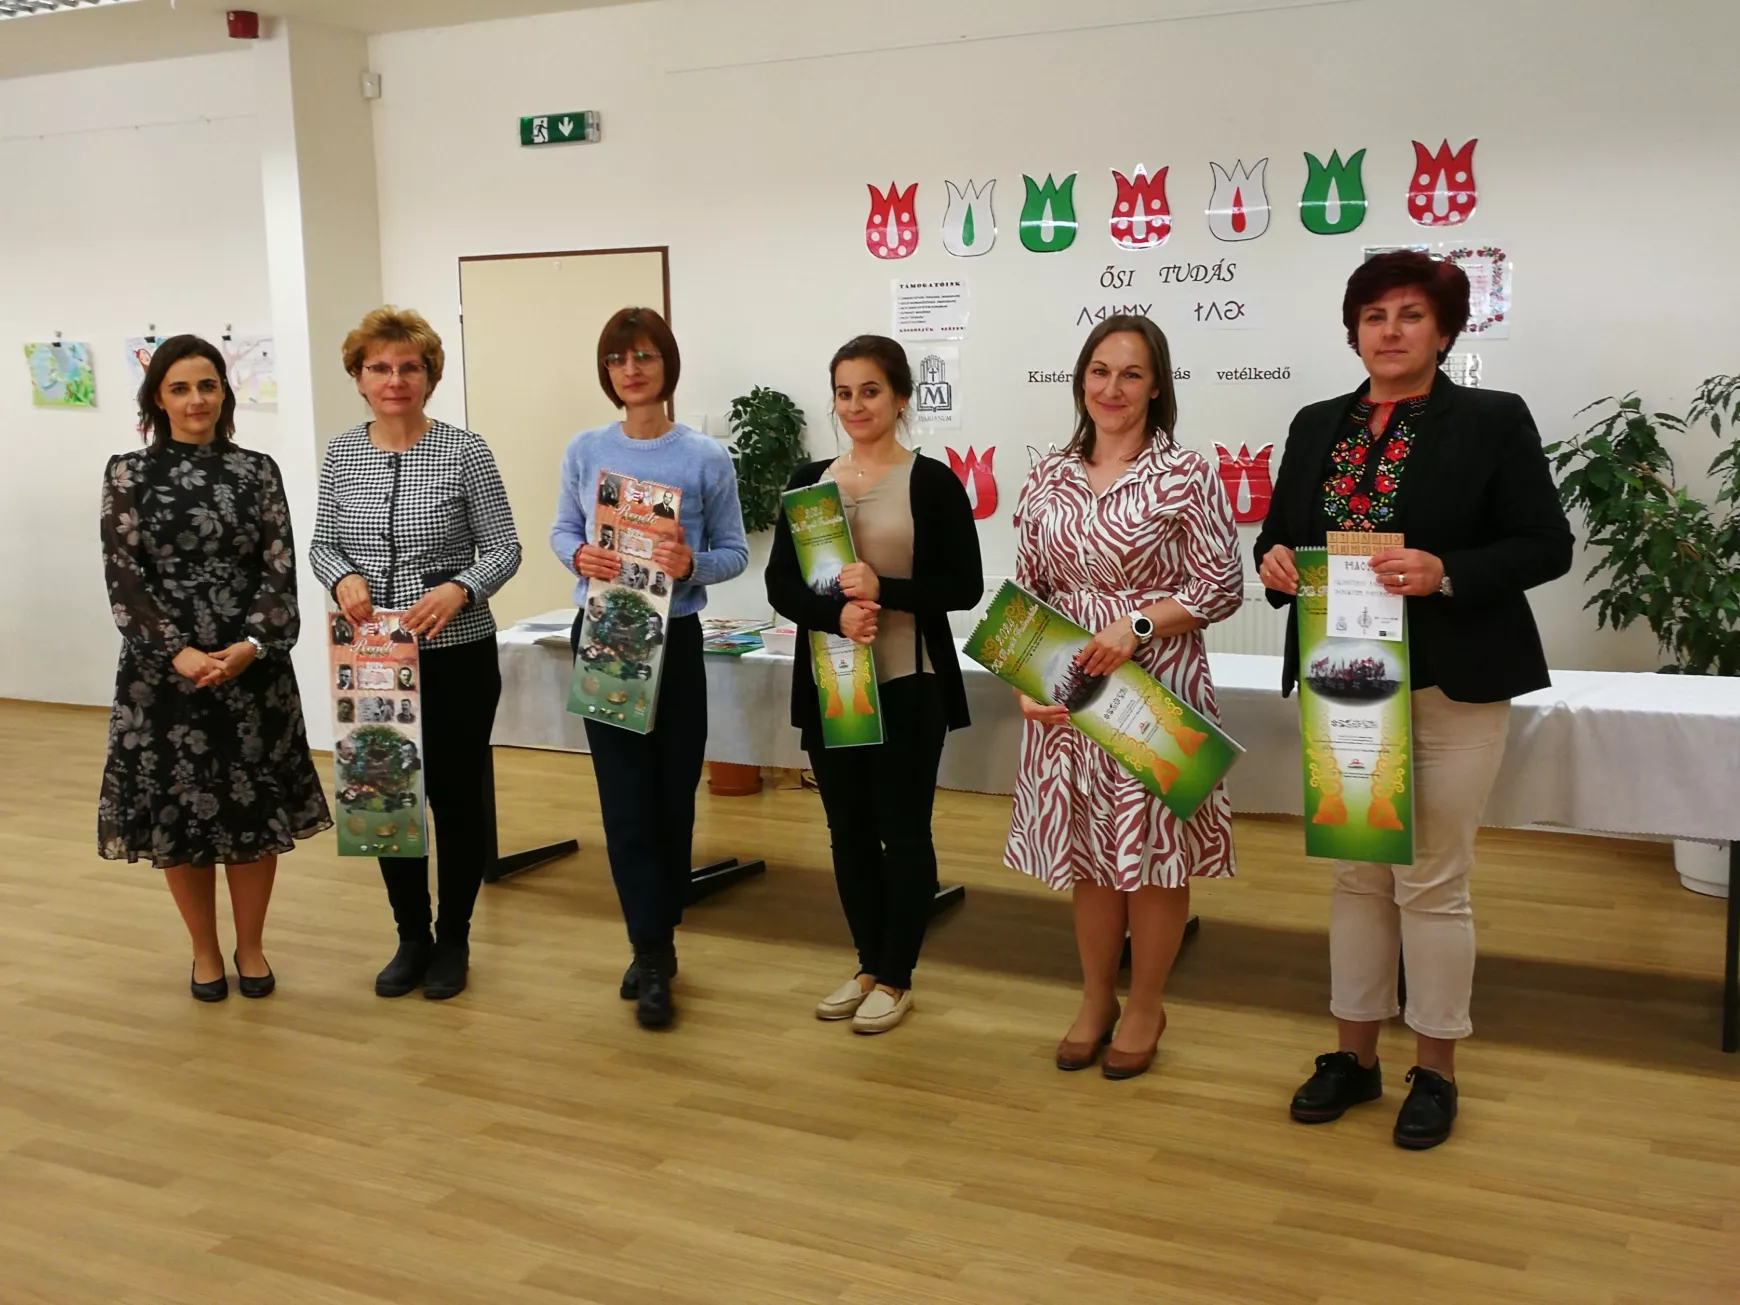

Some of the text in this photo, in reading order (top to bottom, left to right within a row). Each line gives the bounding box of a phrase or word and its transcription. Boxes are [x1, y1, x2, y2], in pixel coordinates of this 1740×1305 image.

[1099, 258, 1237, 289] ŐSI TUDÁS
[1027, 366, 1292, 383] Kistér ás vetélkedő
[922, 386, 946, 404] M
[996, 618, 1015, 646] 2024
